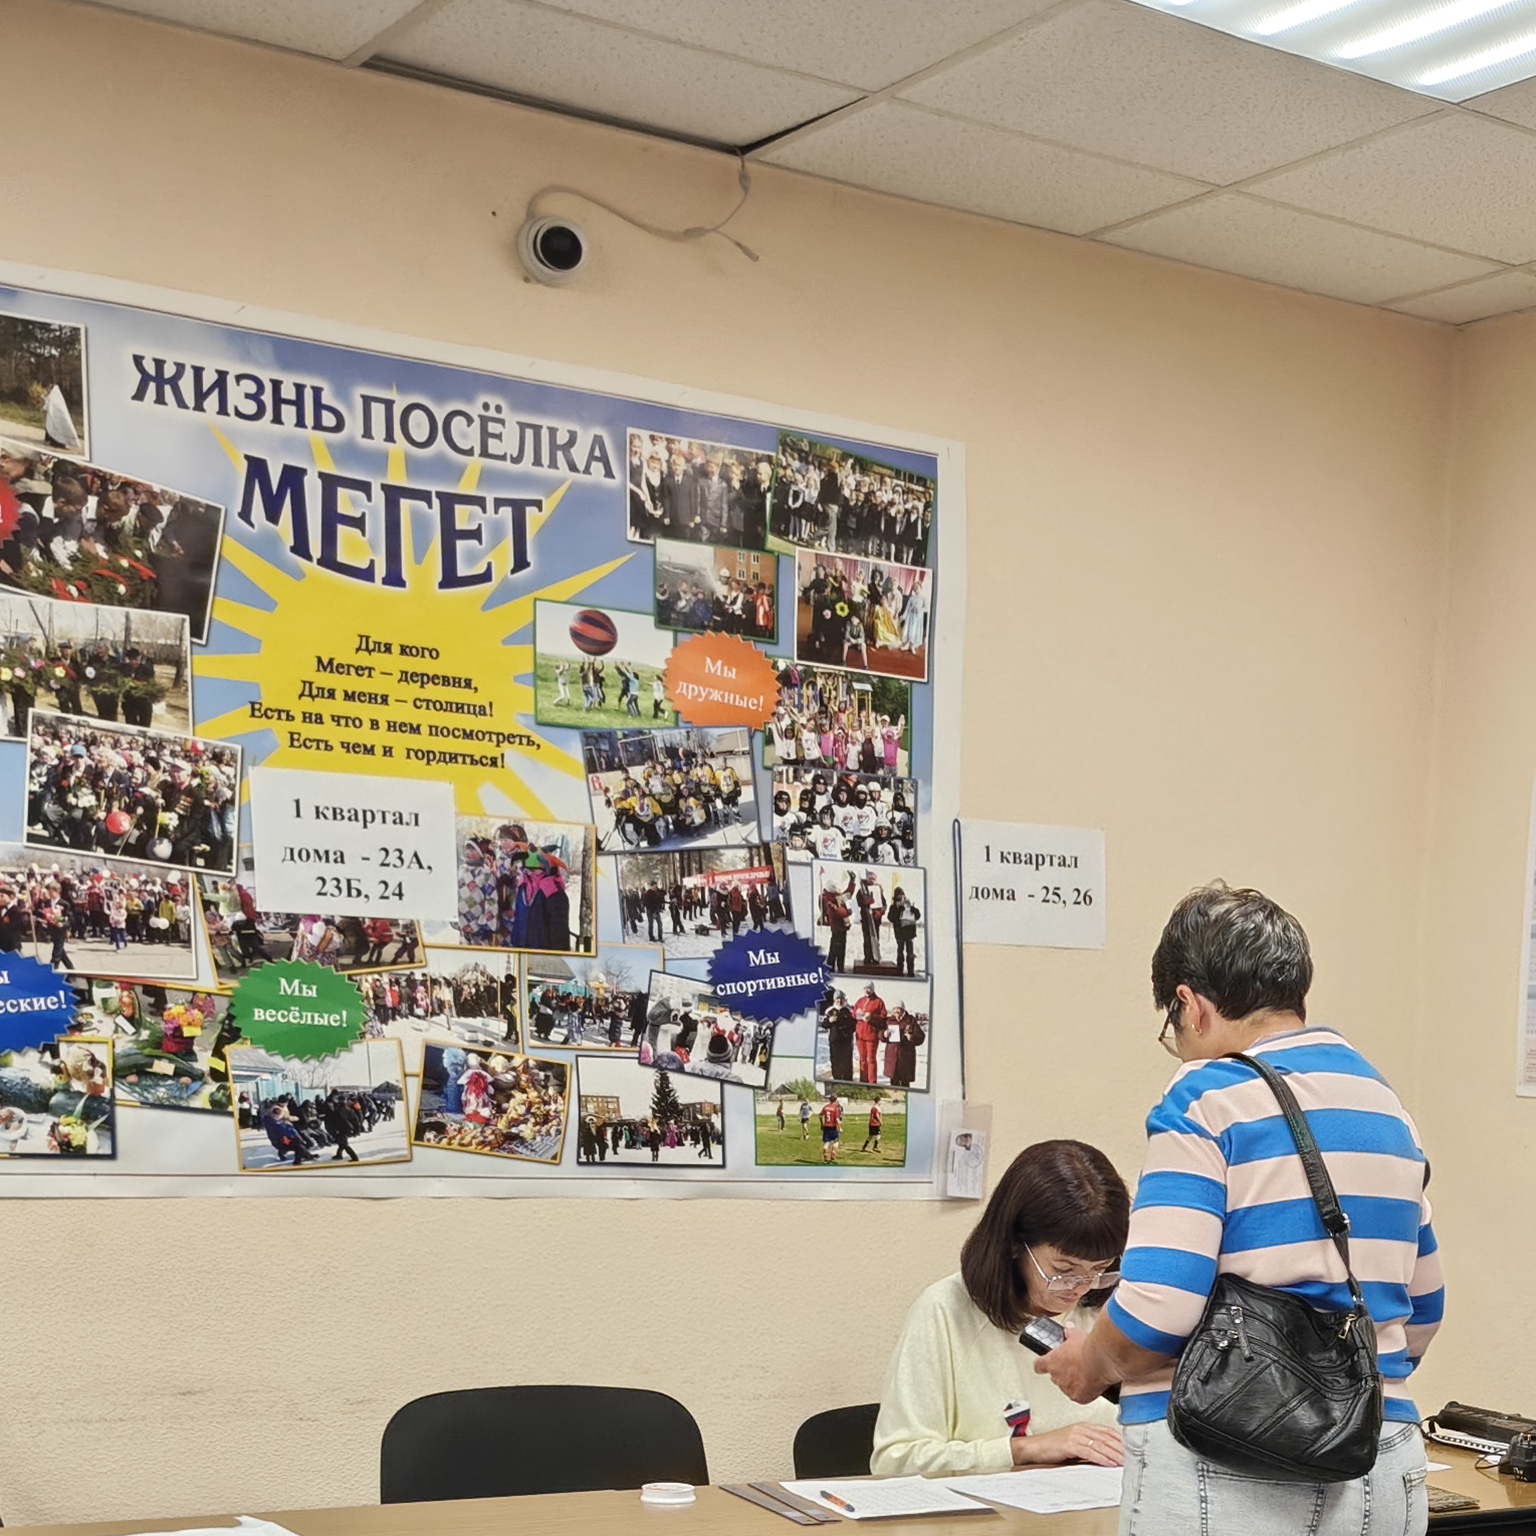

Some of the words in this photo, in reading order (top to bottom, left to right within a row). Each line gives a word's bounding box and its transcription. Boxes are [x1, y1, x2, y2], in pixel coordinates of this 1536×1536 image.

[131, 354, 346, 434] ЖИЗНЬ
[359, 393, 617, 480] ПОСЁЛКА
[237, 453, 543, 590] МЕГЕТ
[355, 634, 393, 656] Для
[399, 643, 440, 660] кого
[315, 656, 375, 678] Мегет
[398, 670, 478, 693] деревня,
[705, 656, 736, 679] Мы
[298, 680, 336, 701] Для
[343, 689, 390, 706] меня
[413, 697, 493, 718] столица!
[675, 681, 764, 712] дружные!
[248, 701, 295, 722] Есть
[301, 711, 324, 725] на
[330, 714, 363, 729] что
[369, 718, 380, 731] в
[386, 720, 421, 735] нем
[428, 724, 541, 750] посмотреть,
[288, 731, 334, 752] Есть
[340, 741, 376, 756] чем
[382, 745, 394, 758] и
[405, 747, 505, 768] гордиться!
[293, 798, 302, 819] 1
[314, 805, 420, 829] квартал
[281, 846, 345, 865] дома
[378, 847, 433, 874] 23А,
[985, 845, 991, 862] 1
[1000, 850, 1078, 871] квартал
[315, 876, 370, 902] 23Б,
[378, 880, 405, 901] 24
[969, 886, 1016, 901] дома
[1041, 885, 1067, 909] 25,
[1072, 888, 1093, 906] 26
[747, 949, 780, 967] Мы
[278, 977, 318, 998] Мы
[716, 967, 824, 997] спортивные!
[253, 1006, 347, 1028] весёлые!
